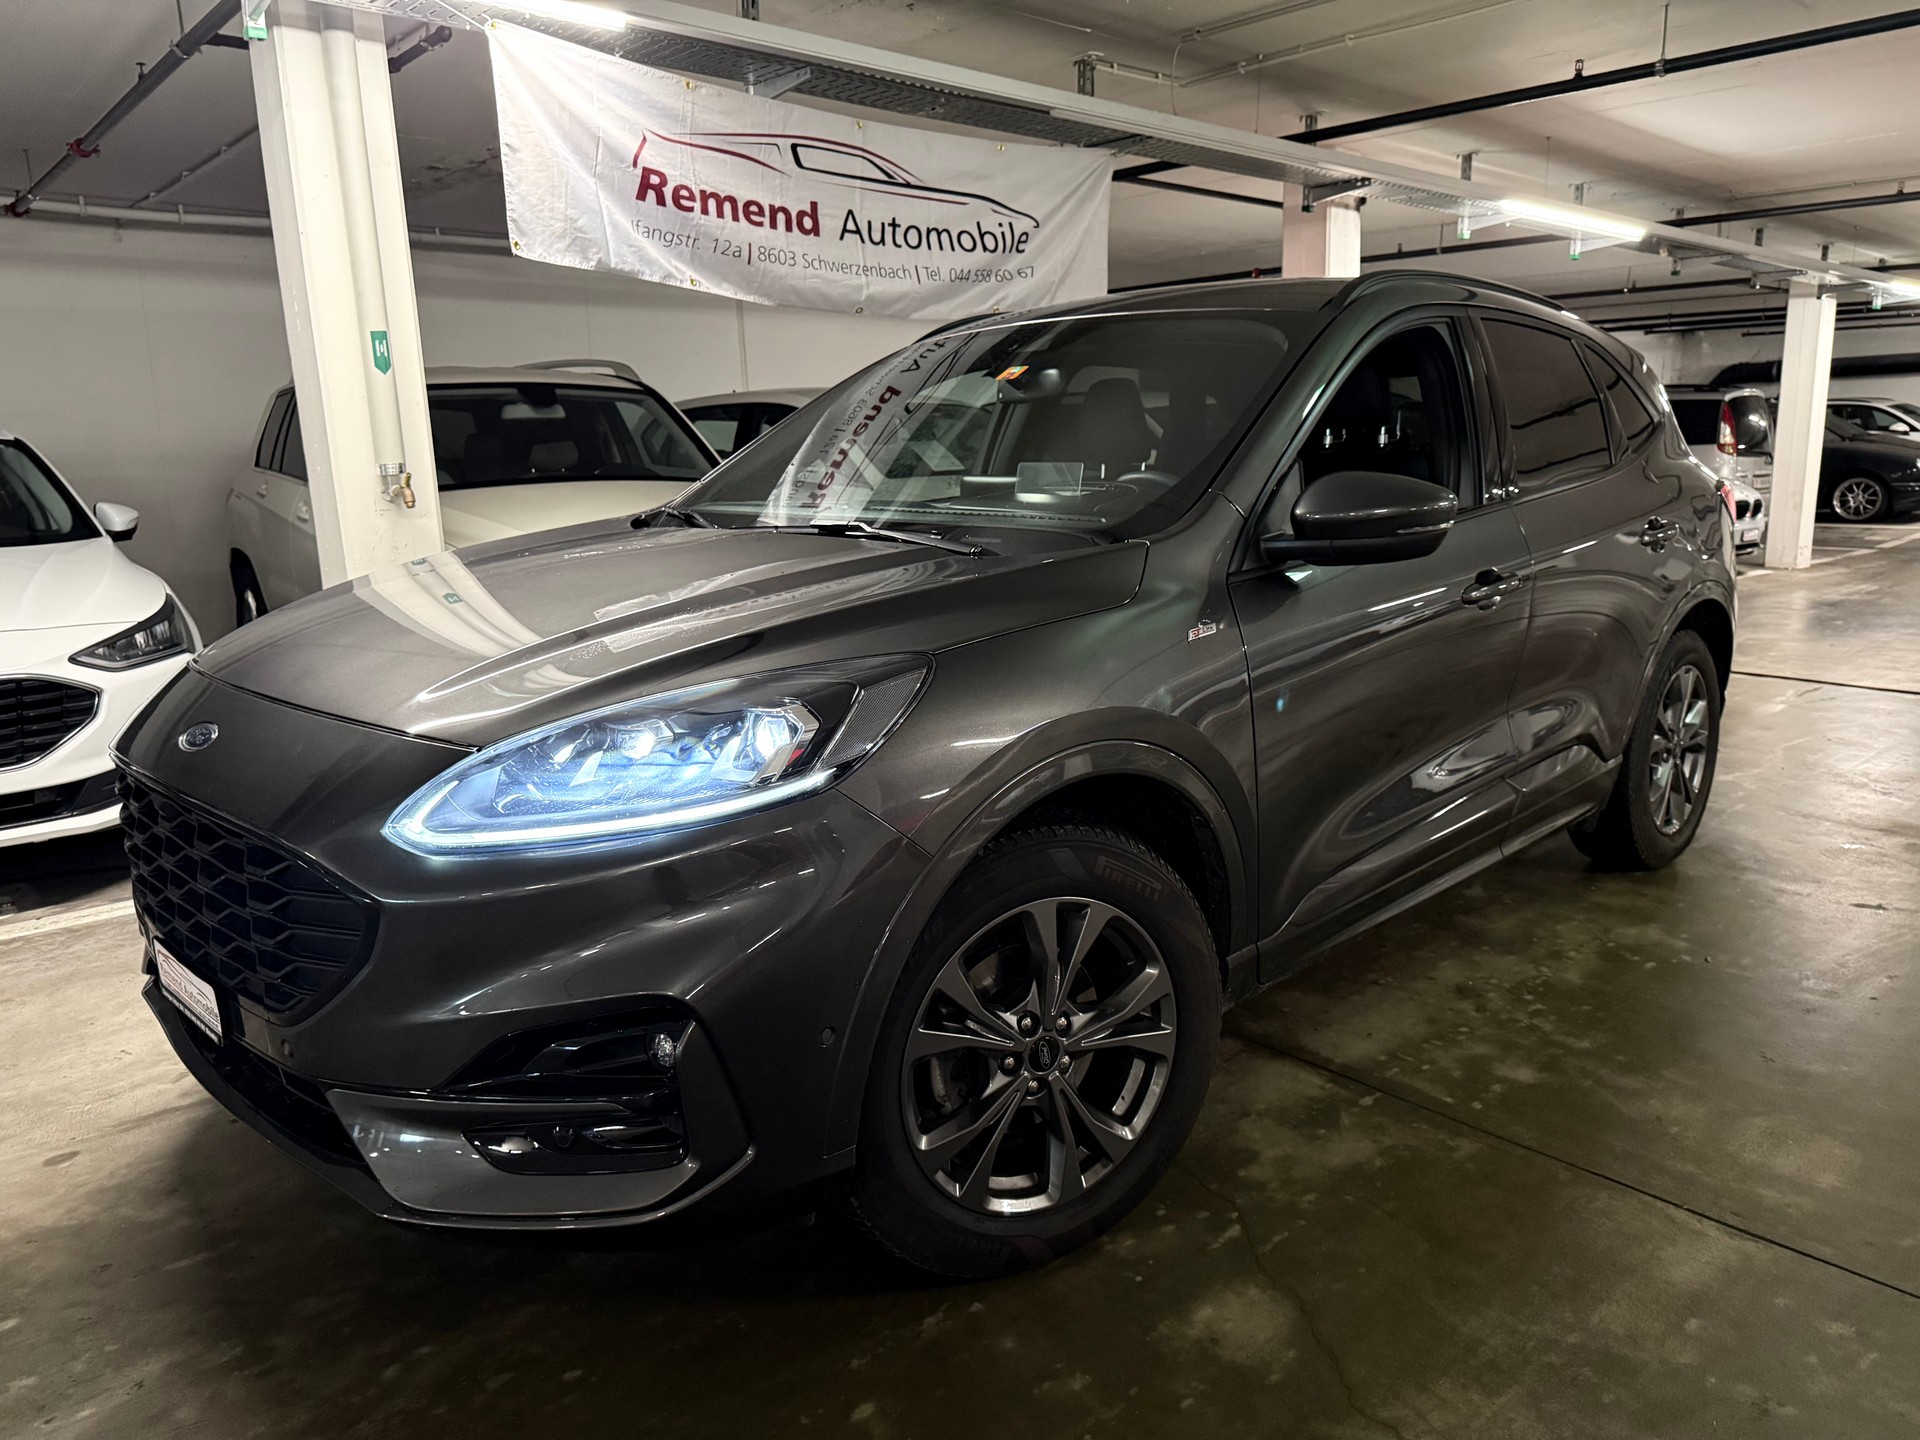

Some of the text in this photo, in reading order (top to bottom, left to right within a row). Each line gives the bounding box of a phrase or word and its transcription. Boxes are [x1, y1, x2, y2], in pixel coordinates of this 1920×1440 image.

[635, 165, 1029, 254] Remend Automobile
[711, 238, 742, 259] 12a
[757, 245, 797, 267] 8603
[802, 254, 912, 281] Schwerzenbach
[922, 266, 945, 282] Tel.
[950, 268, 971, 283] 044
[971, 269, 992, 283] 558
[995, 268, 1013, 283] 60
[1017, 266, 1034, 279] 67
[1093, 855, 1162, 902] PIRELLI
